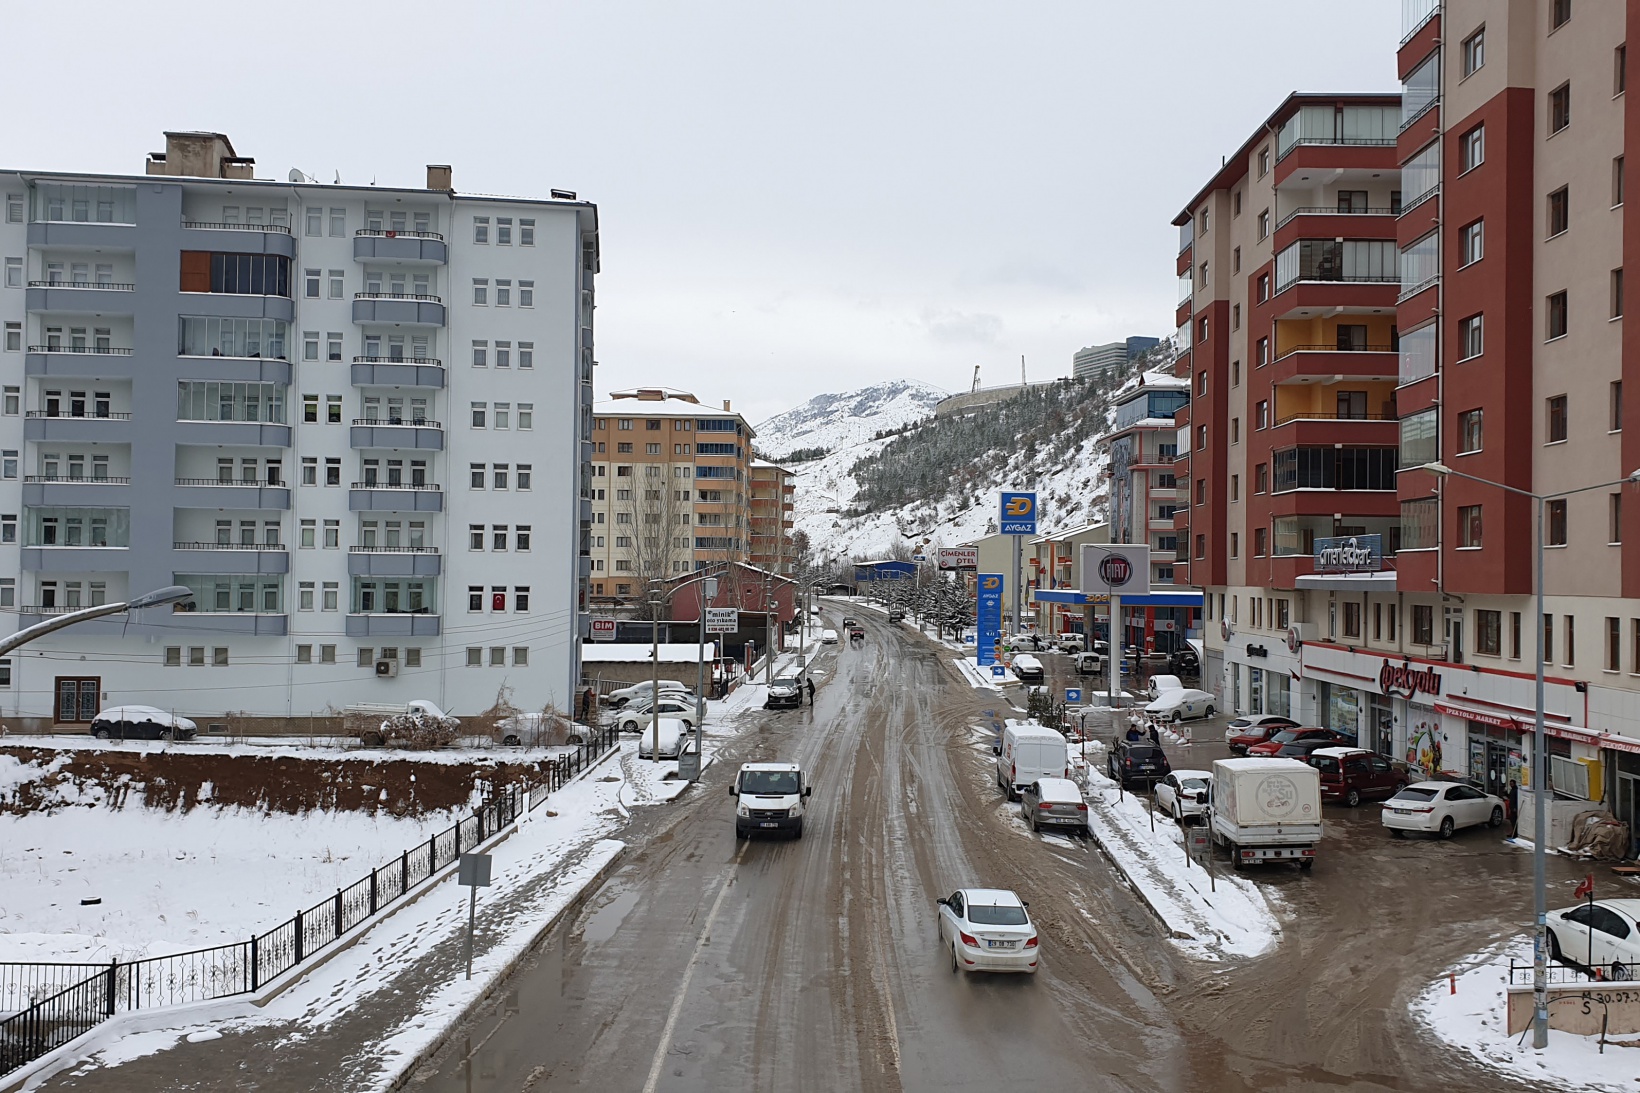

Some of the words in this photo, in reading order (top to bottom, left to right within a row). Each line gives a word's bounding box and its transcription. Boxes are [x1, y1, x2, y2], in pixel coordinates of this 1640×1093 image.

[1004, 524, 1032, 532] AYGAZ
[941, 550, 976, 558] ÇİMENLER
[1106, 564, 1126, 578] FIAT
[1476, 714, 1502, 725] MARKET
[1581, 1001, 1592, 1015] S
